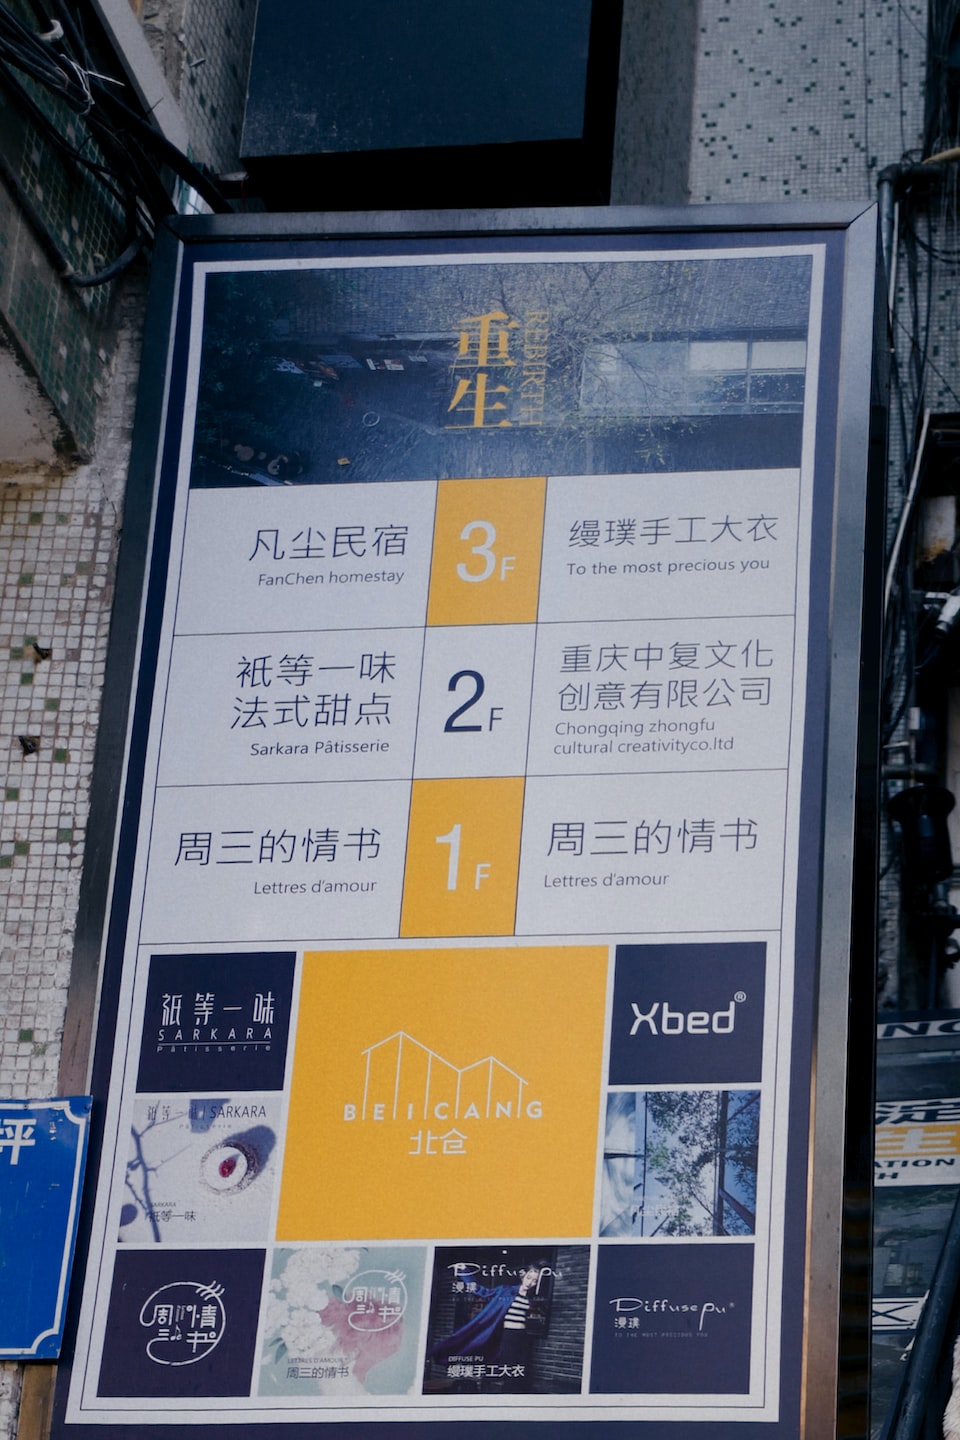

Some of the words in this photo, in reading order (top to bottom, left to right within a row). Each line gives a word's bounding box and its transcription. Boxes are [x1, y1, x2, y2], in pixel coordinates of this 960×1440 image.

[445, 310, 520, 429] 重生
[519, 311, 549, 426] REBIRTH
[249, 524, 409, 562] 凡尘民宿
[567, 513, 779, 548] 缦璞手工大衣
[257, 572, 325, 587] FanChen
[328, 570, 405, 585] homestay
[567, 562, 587, 576] To
[592, 562, 617, 575] the
[622, 561, 662, 574] most
[667, 559, 735, 576] precious
[740, 558, 770, 573] you
[559, 638, 774, 673] 重庆中复文化
[557, 676, 772, 712] 创意有限公司
[230, 692, 392, 730] 法式甜点
[554, 720, 644, 737] Chongqing
[649, 718, 715, 735] zhongfu
[249, 743, 309, 757] Sarkara
[314, 740, 390, 755] Pâtisserie
[553, 741, 613, 755] cultural
[174, 827, 382, 867] 周三的情书
[546, 817, 758, 857] 周三的情书
[253, 881, 307, 895] Lettres
[311, 880, 377, 894] d'amour
[543, 874, 598, 888] Lettres
[602, 873, 669, 887] d'amour
[158, 1027, 272, 1042] SARKARA
[343, 1101, 543, 1121] BEICANG
[408, 1128, 468, 1155] 北仓
